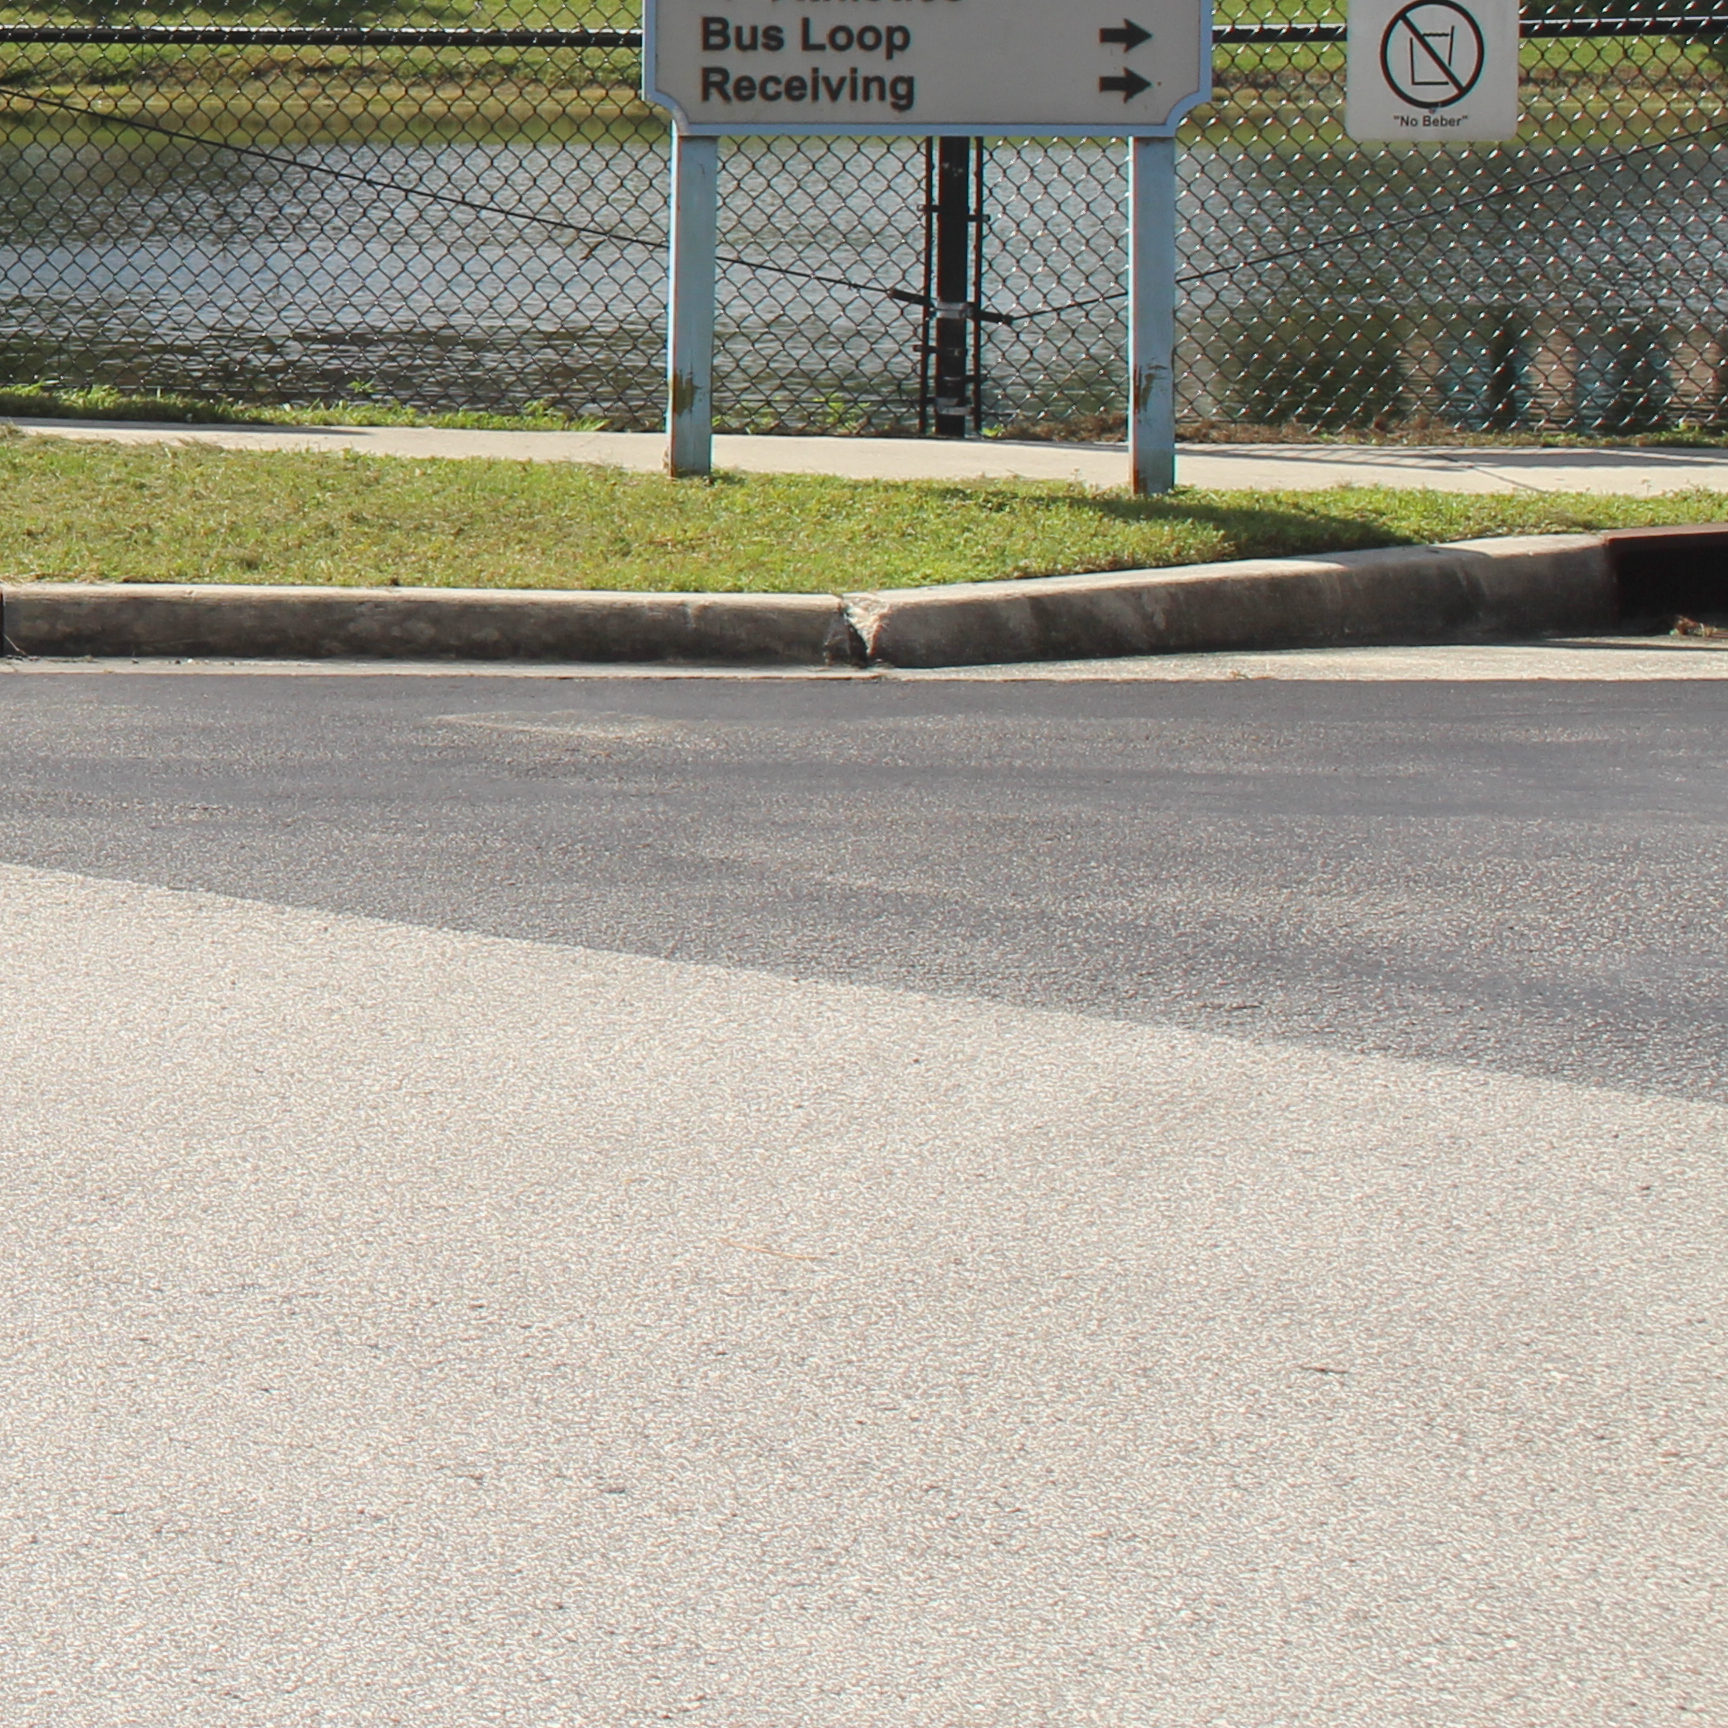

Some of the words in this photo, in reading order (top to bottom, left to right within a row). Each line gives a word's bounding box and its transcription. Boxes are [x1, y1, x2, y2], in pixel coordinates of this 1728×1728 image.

[700, 16, 785, 52] Bus
[800, 16, 912, 59] Loop
[700, 67, 916, 111] Receiving
[1393, 114, 1418, 127] "No
[1422, 114, 1468, 127] Beber"
